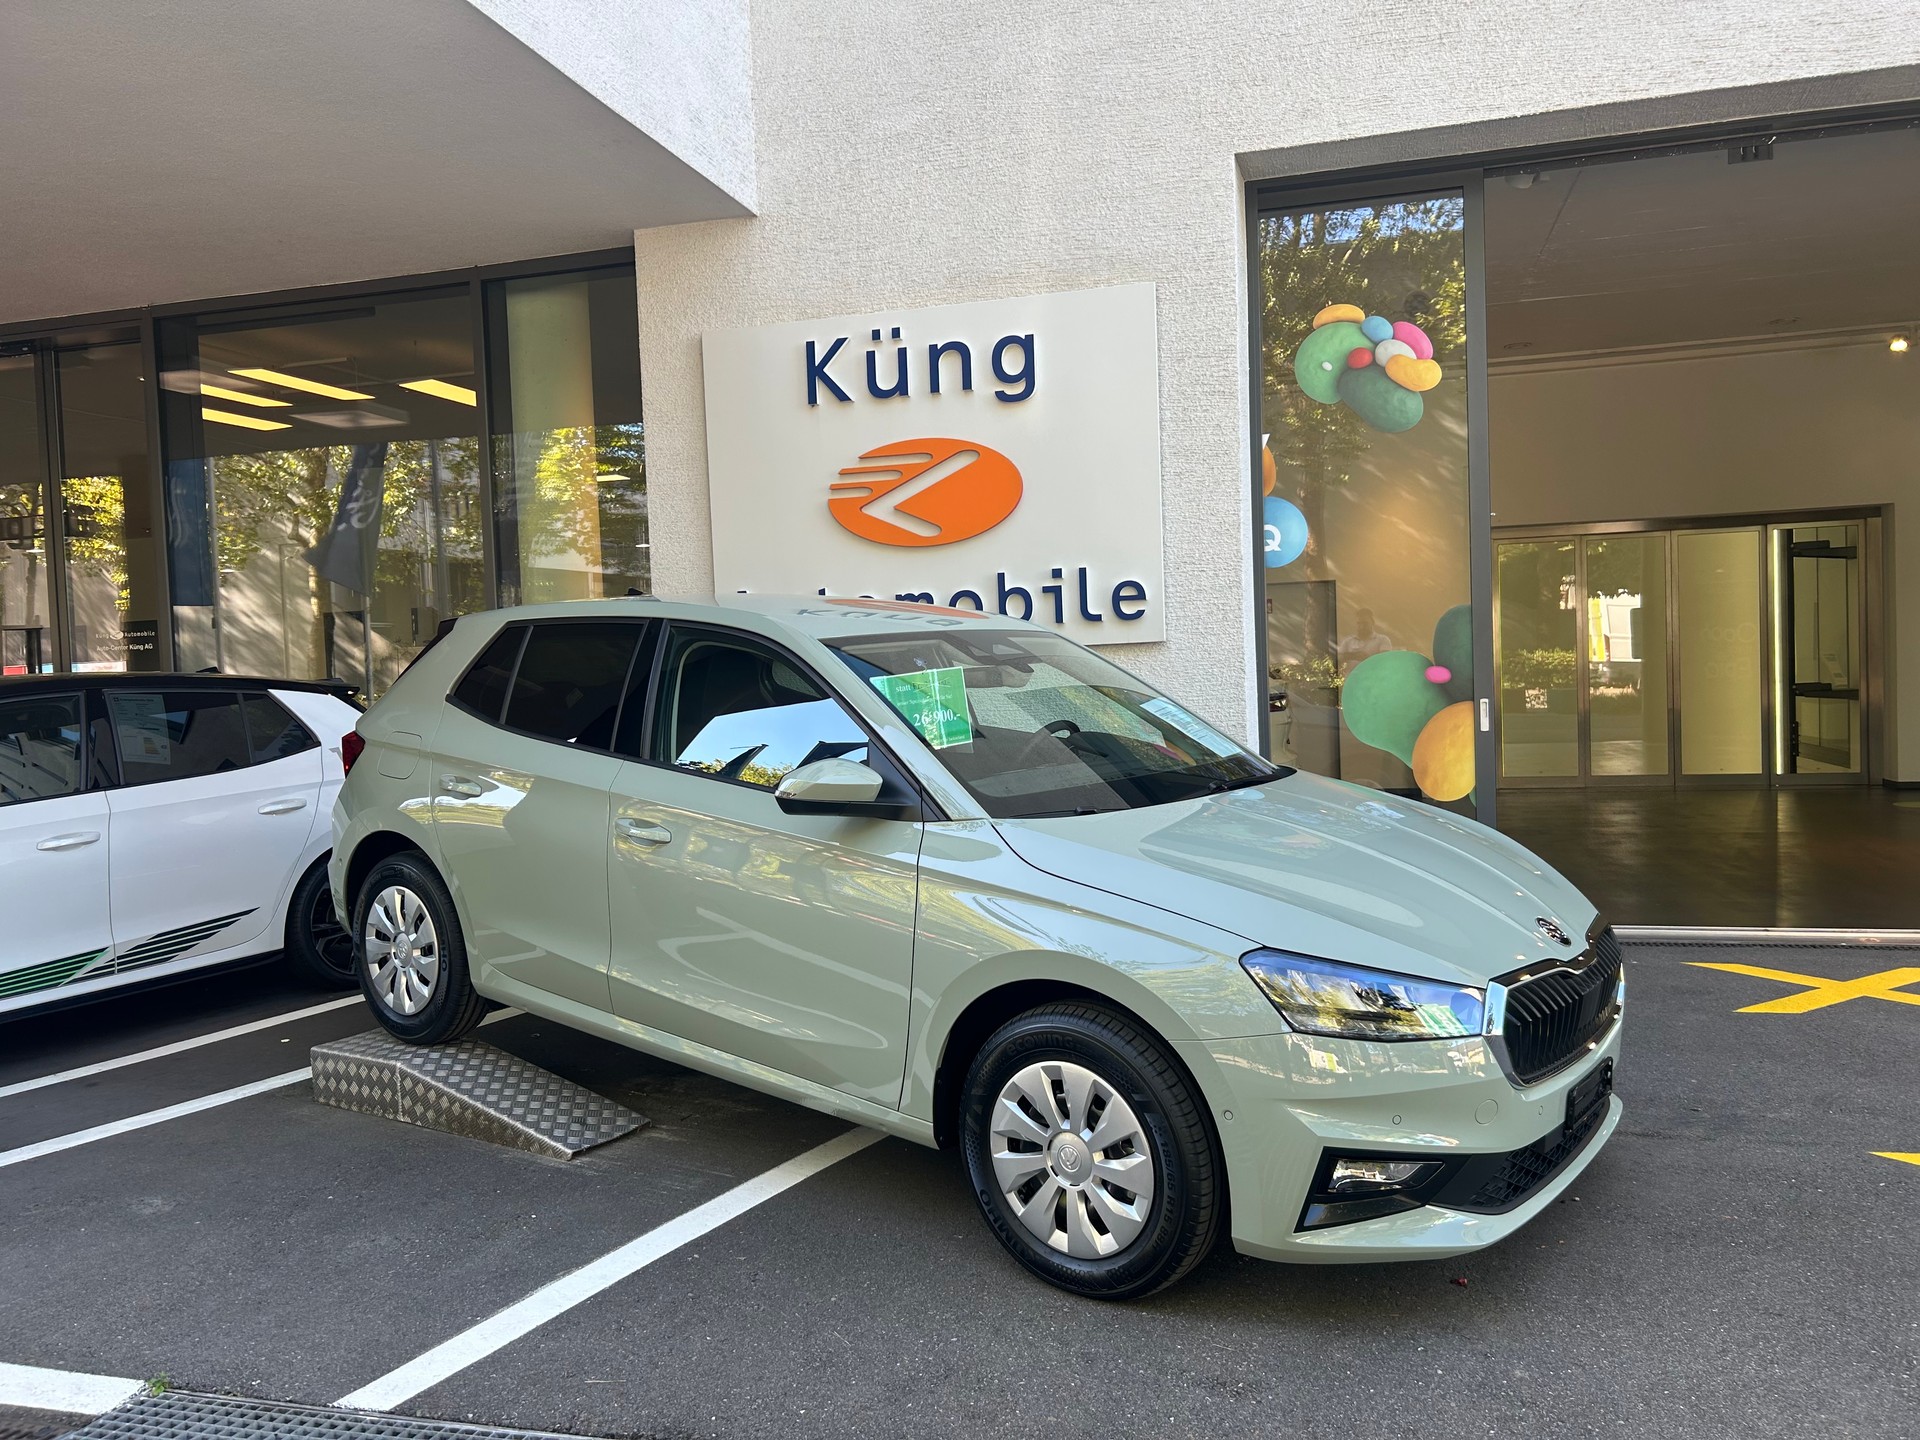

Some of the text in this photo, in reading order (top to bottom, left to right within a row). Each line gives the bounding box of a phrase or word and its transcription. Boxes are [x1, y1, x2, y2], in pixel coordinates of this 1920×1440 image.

[805, 326, 1037, 406] Küng
[129, 643, 144, 651] Küng
[144, 642, 154, 650] AG
[895, 684, 911, 693] statt
